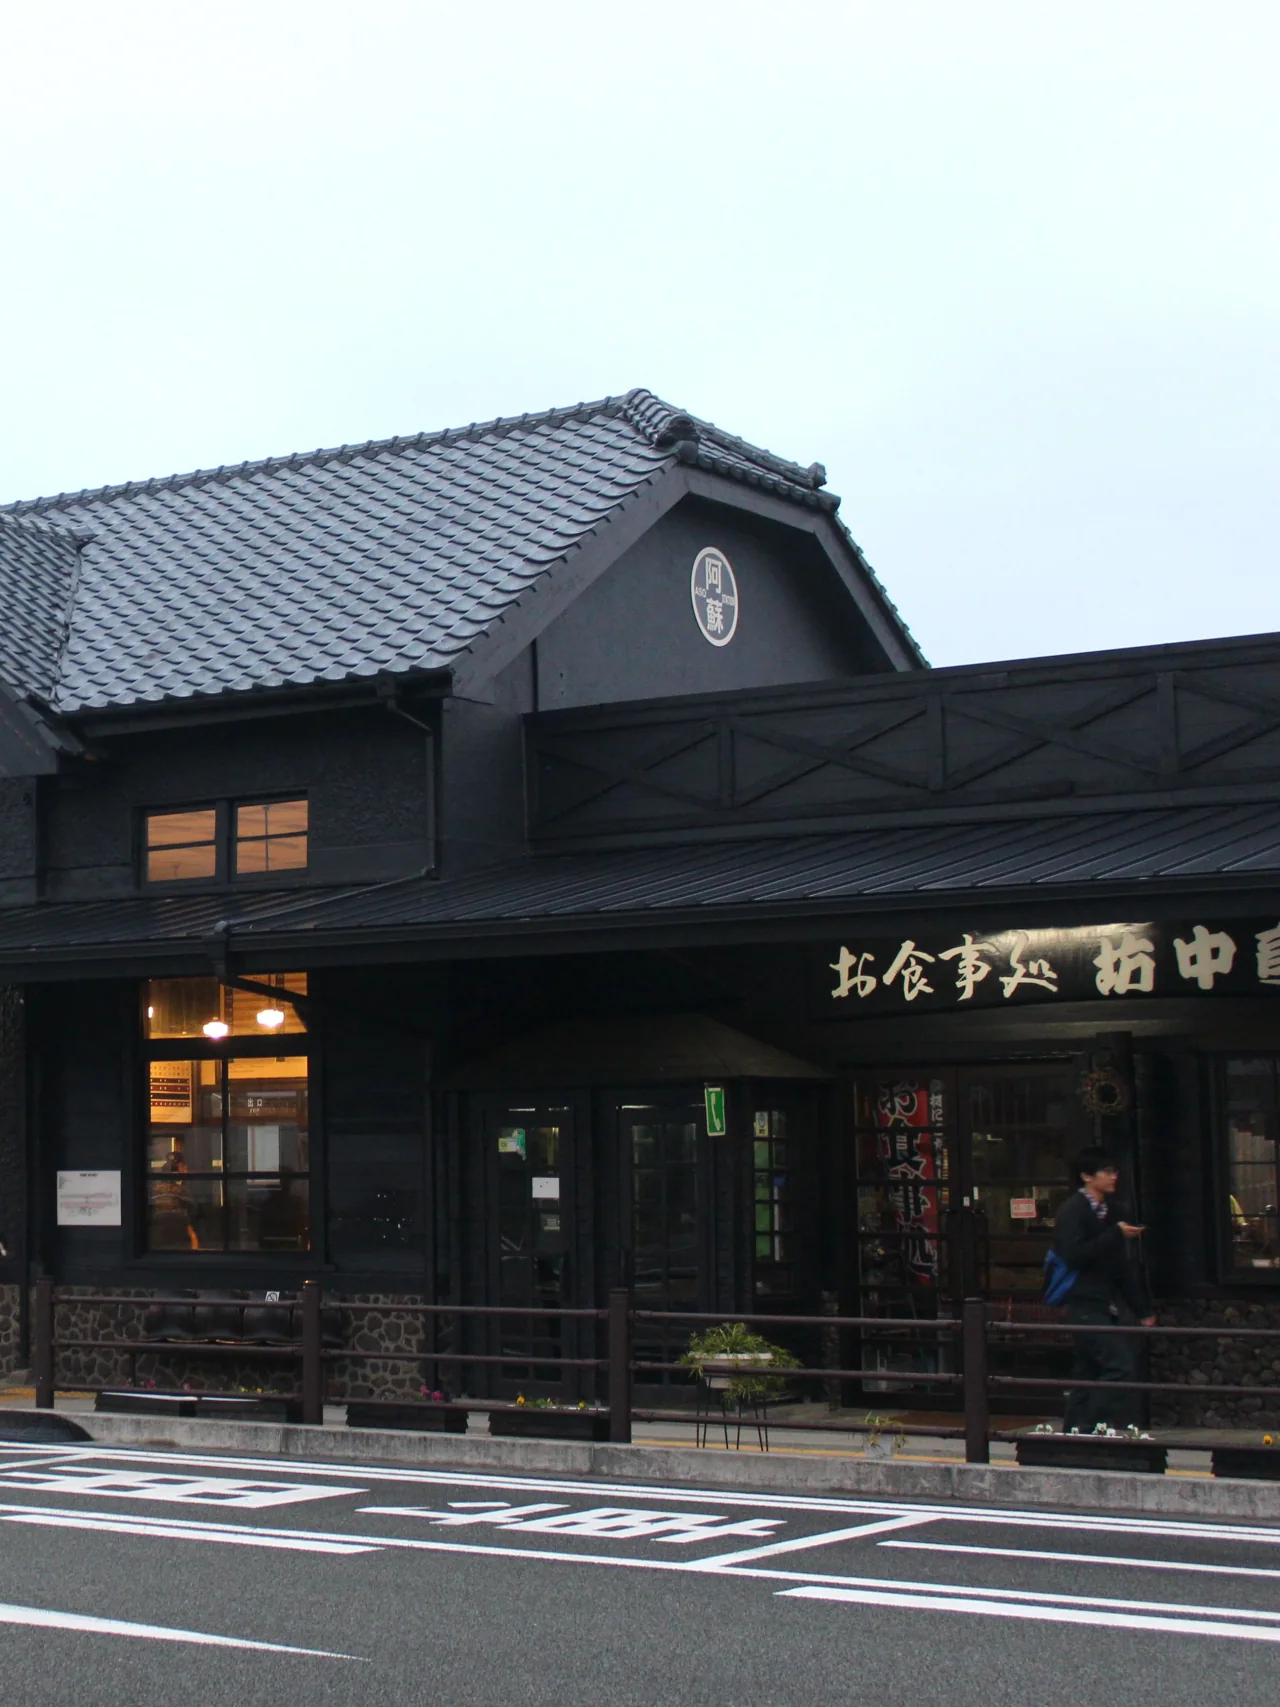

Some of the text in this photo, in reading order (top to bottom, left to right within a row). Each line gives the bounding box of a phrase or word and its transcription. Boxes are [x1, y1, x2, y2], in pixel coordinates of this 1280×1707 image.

[705, 557, 723, 633] 阿蘇
[829, 929, 1059, 1001] お食事処
